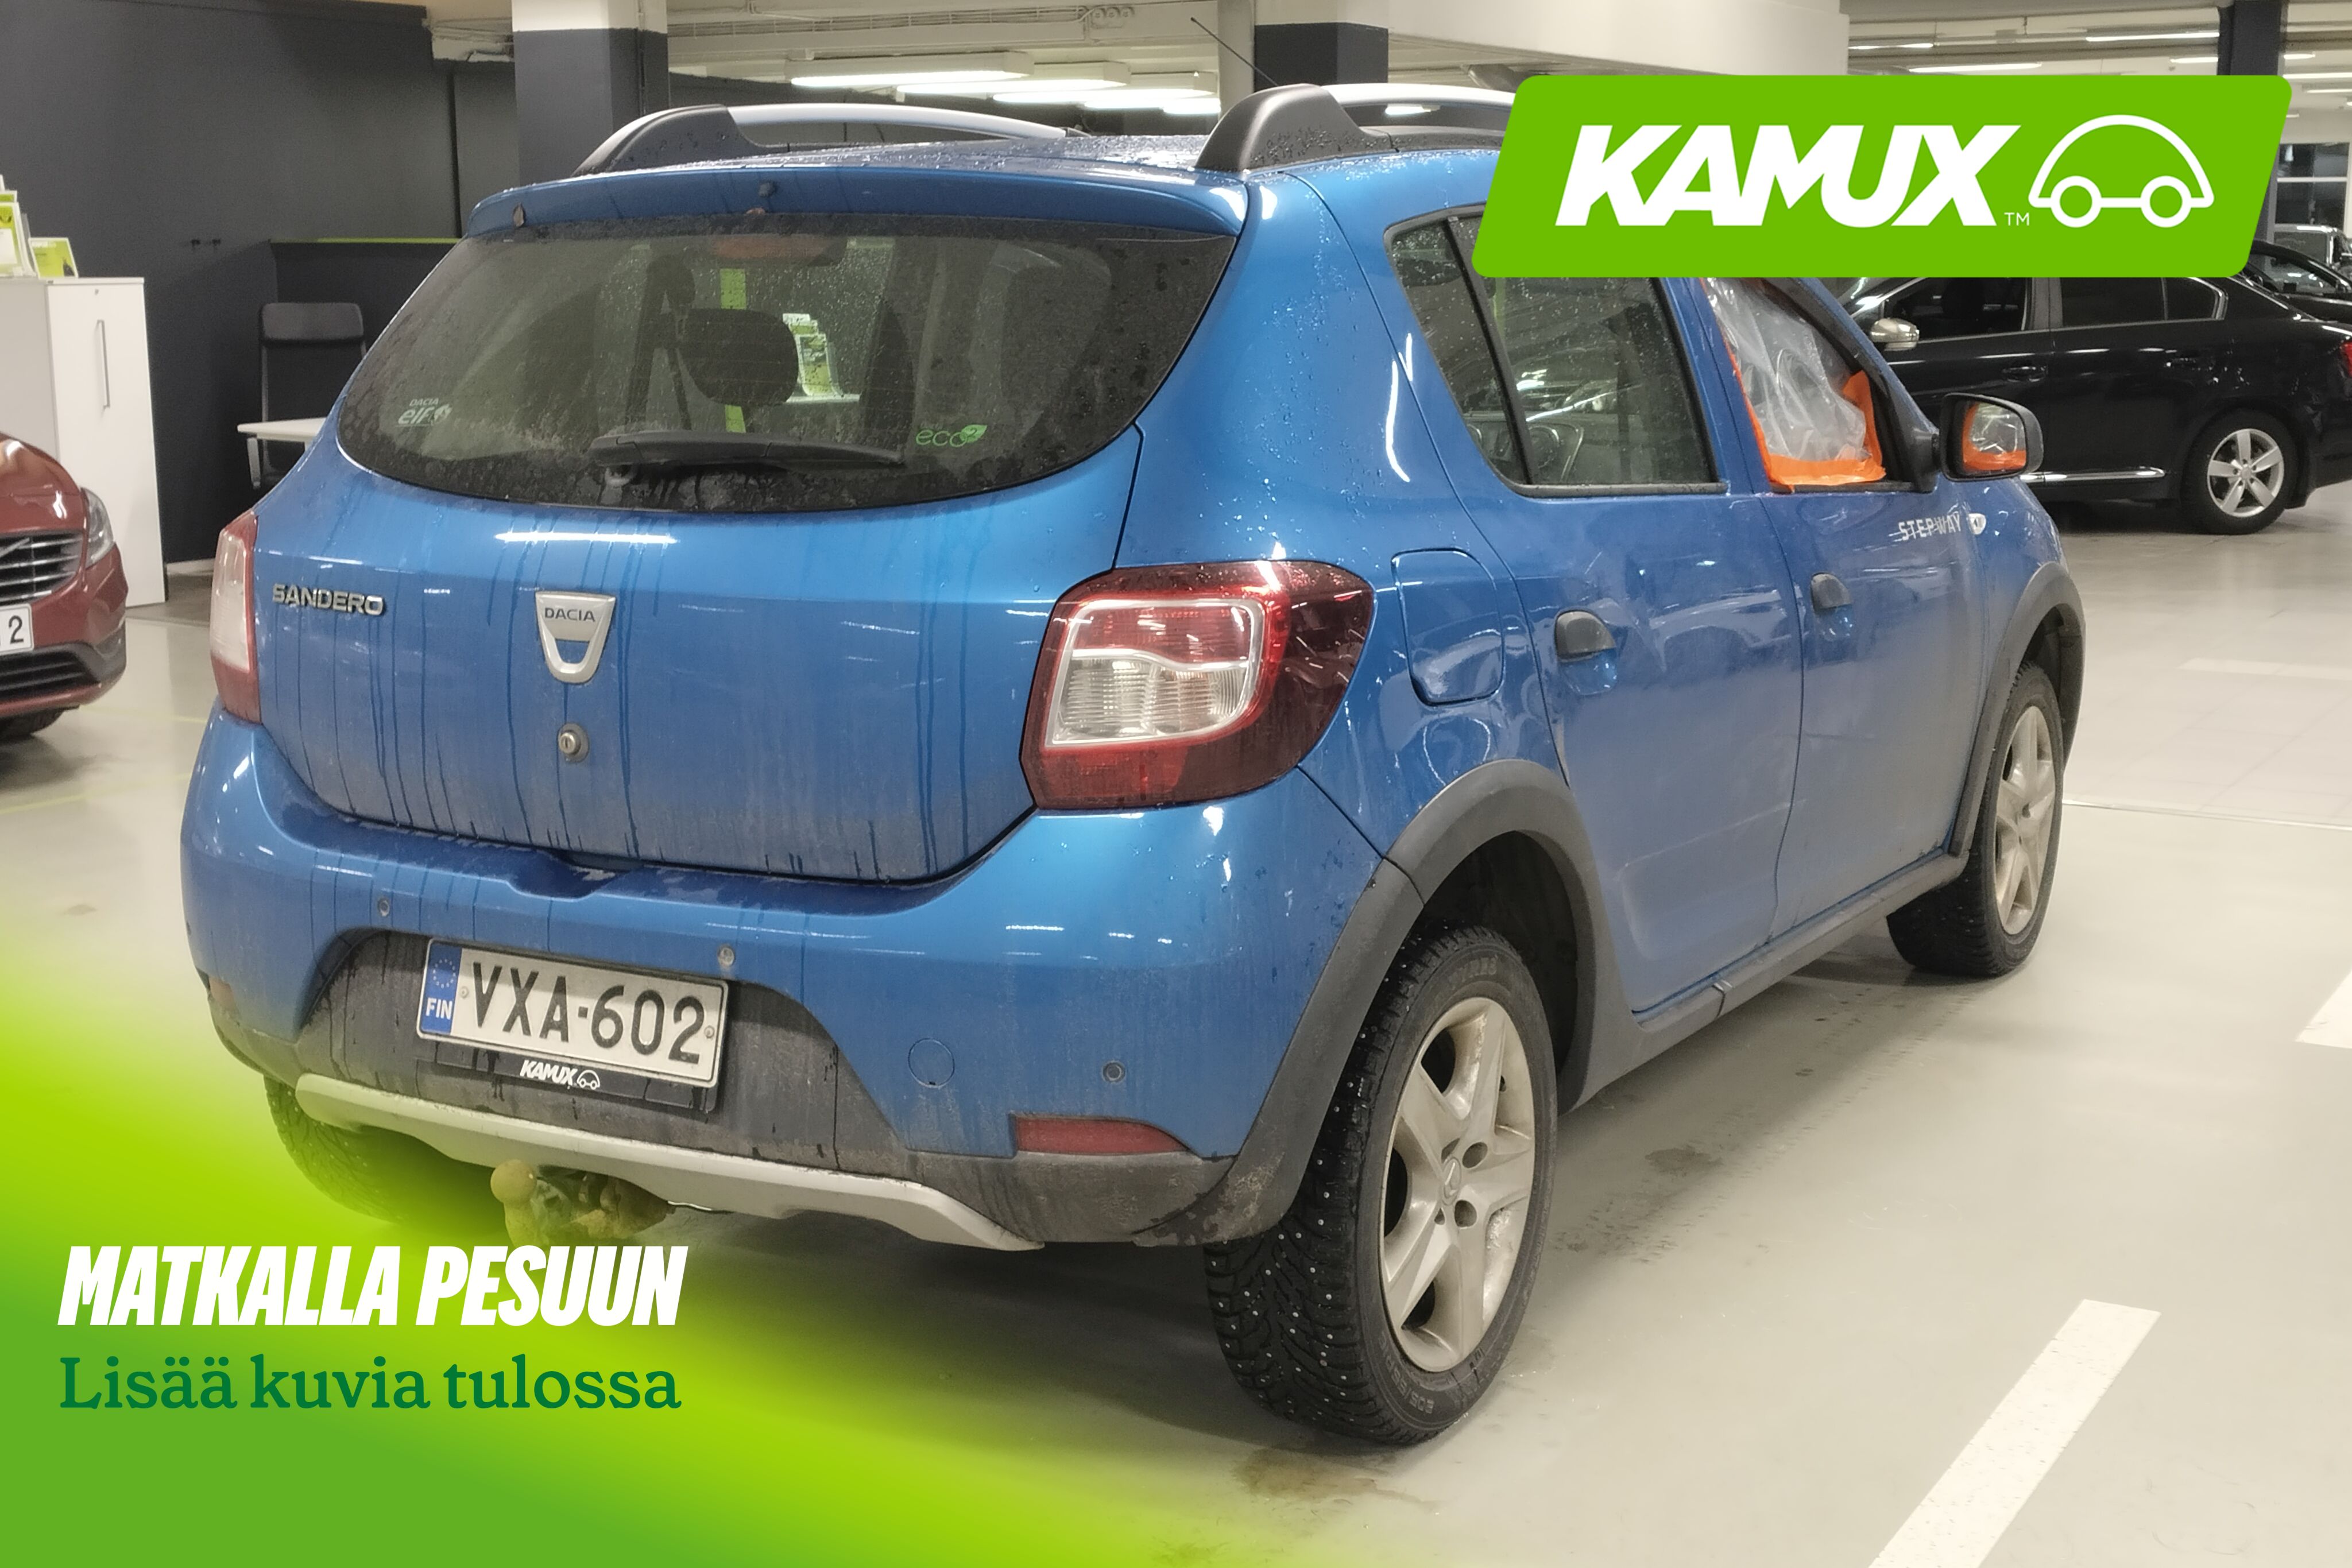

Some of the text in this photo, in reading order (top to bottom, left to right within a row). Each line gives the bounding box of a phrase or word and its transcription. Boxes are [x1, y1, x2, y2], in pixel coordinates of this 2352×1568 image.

[409, 397, 439, 406] DACIA
[398, 406, 435, 423] elf
[1898, 513, 1961, 541] STEPWAY
[272, 583, 385, 615] SANDERO
[544, 607, 595, 622] DACIA
[425, 997, 452, 1020] FIN
[473, 961, 705, 1064] VXA-602
[520, 1059, 578, 1087] KAMUX
